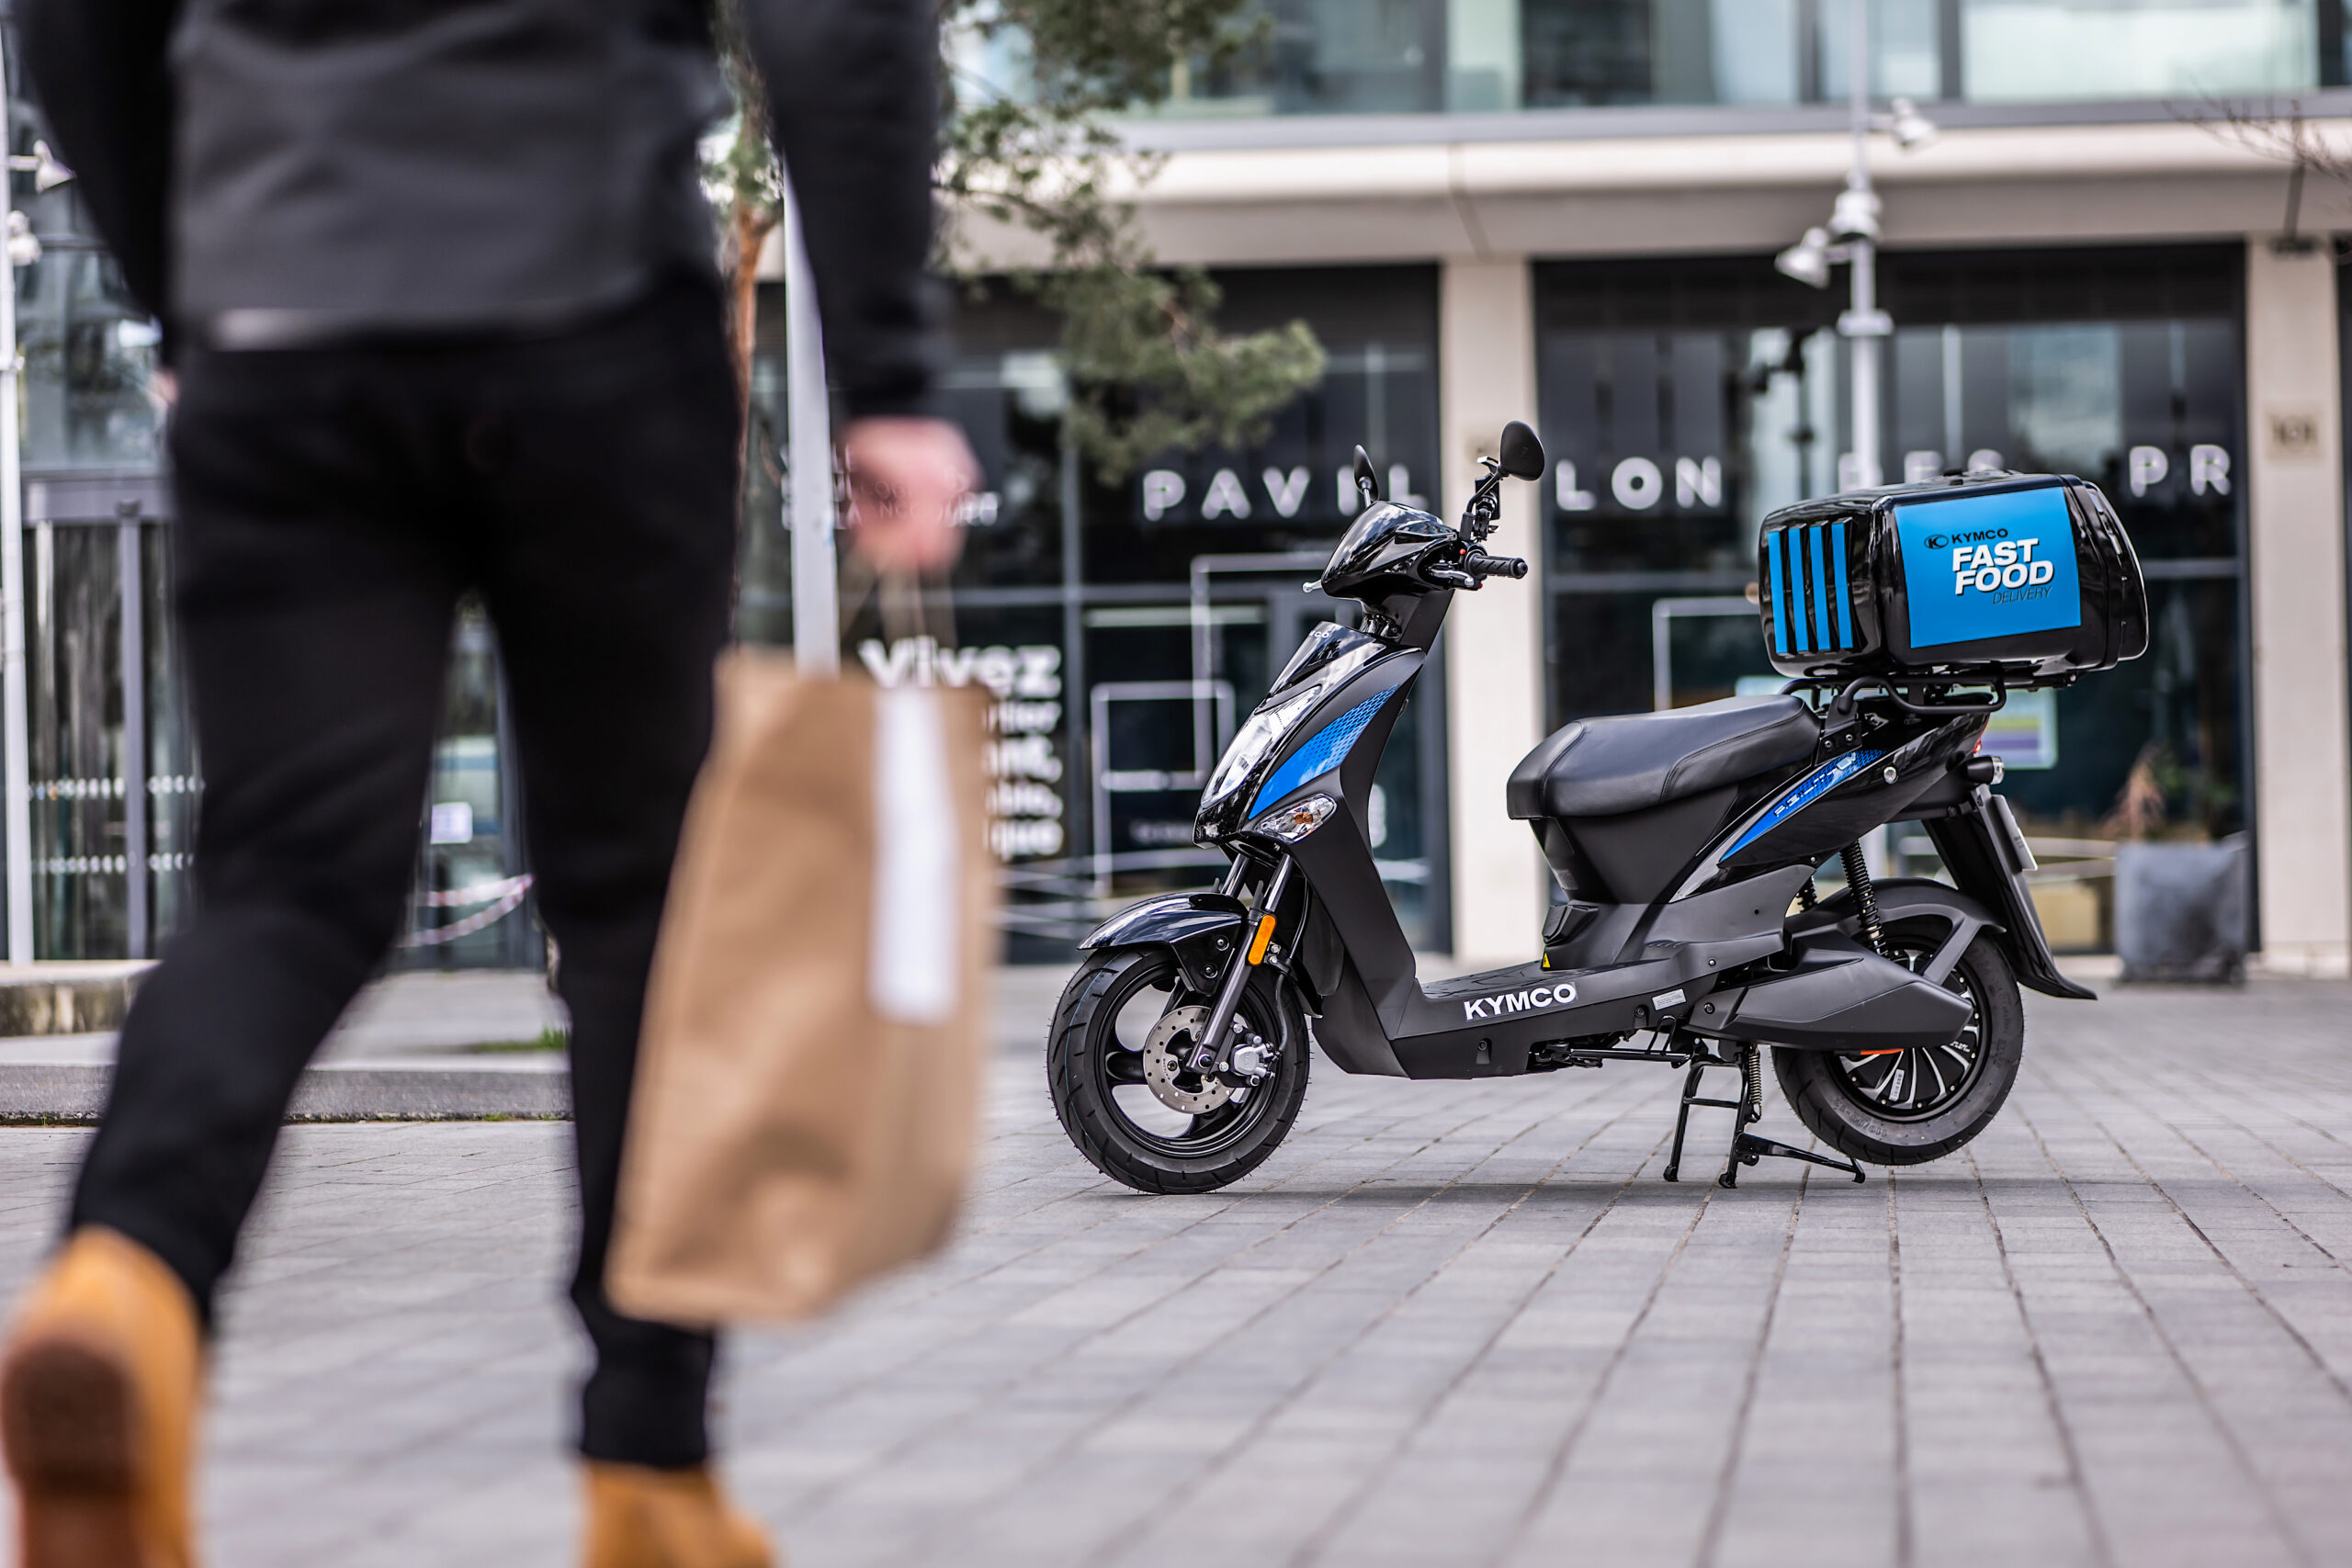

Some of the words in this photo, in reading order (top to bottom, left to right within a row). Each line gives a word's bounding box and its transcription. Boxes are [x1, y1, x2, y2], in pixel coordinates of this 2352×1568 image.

[1951, 528, 2008, 544] KYMCO
[1952, 538, 2039, 571] FAST
[1955, 560, 2054, 595] FOOD
[1993, 586, 2053, 604] DELIVERY
[1464, 983, 1577, 1021] KYMCO
